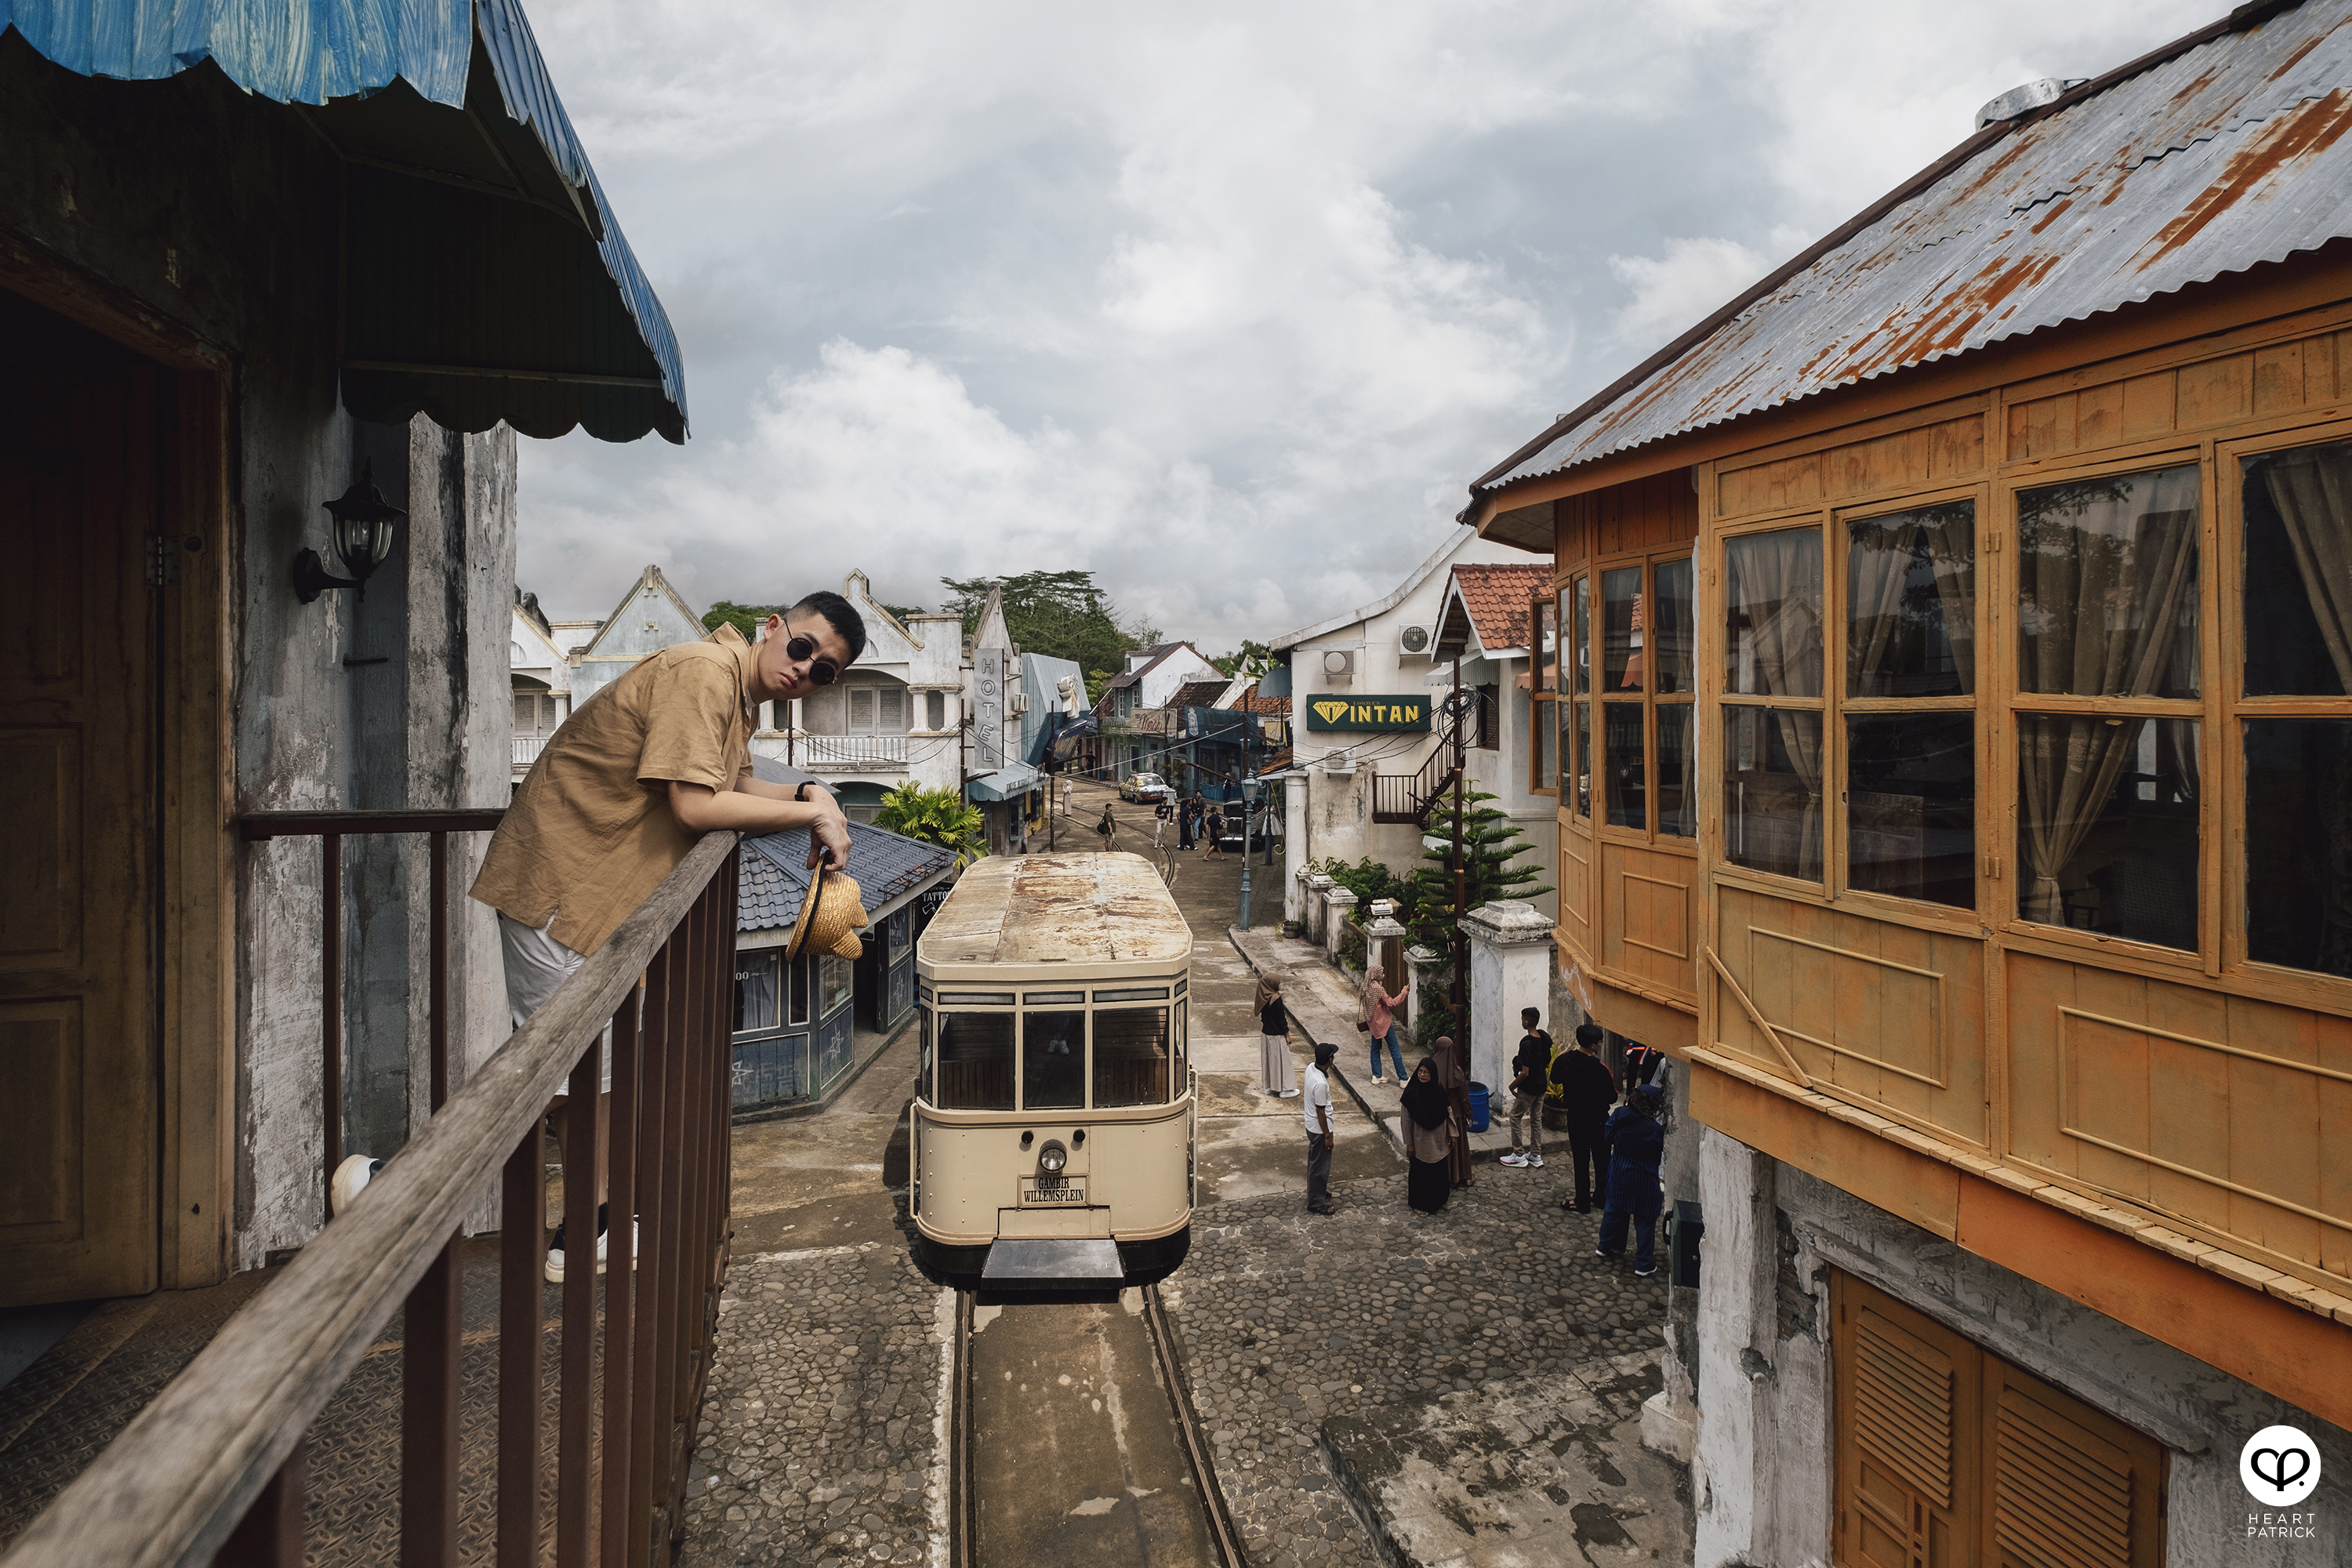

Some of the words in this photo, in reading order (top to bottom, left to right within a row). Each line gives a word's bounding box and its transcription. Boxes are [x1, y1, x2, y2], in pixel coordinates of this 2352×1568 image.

[978, 658, 996, 763] HOTEL
[1350, 705, 1420, 723] INTAN
[1038, 1177, 1069, 1189] GAMBIR
[1024, 1189, 1083, 1202] WILLEMSPLEIN
